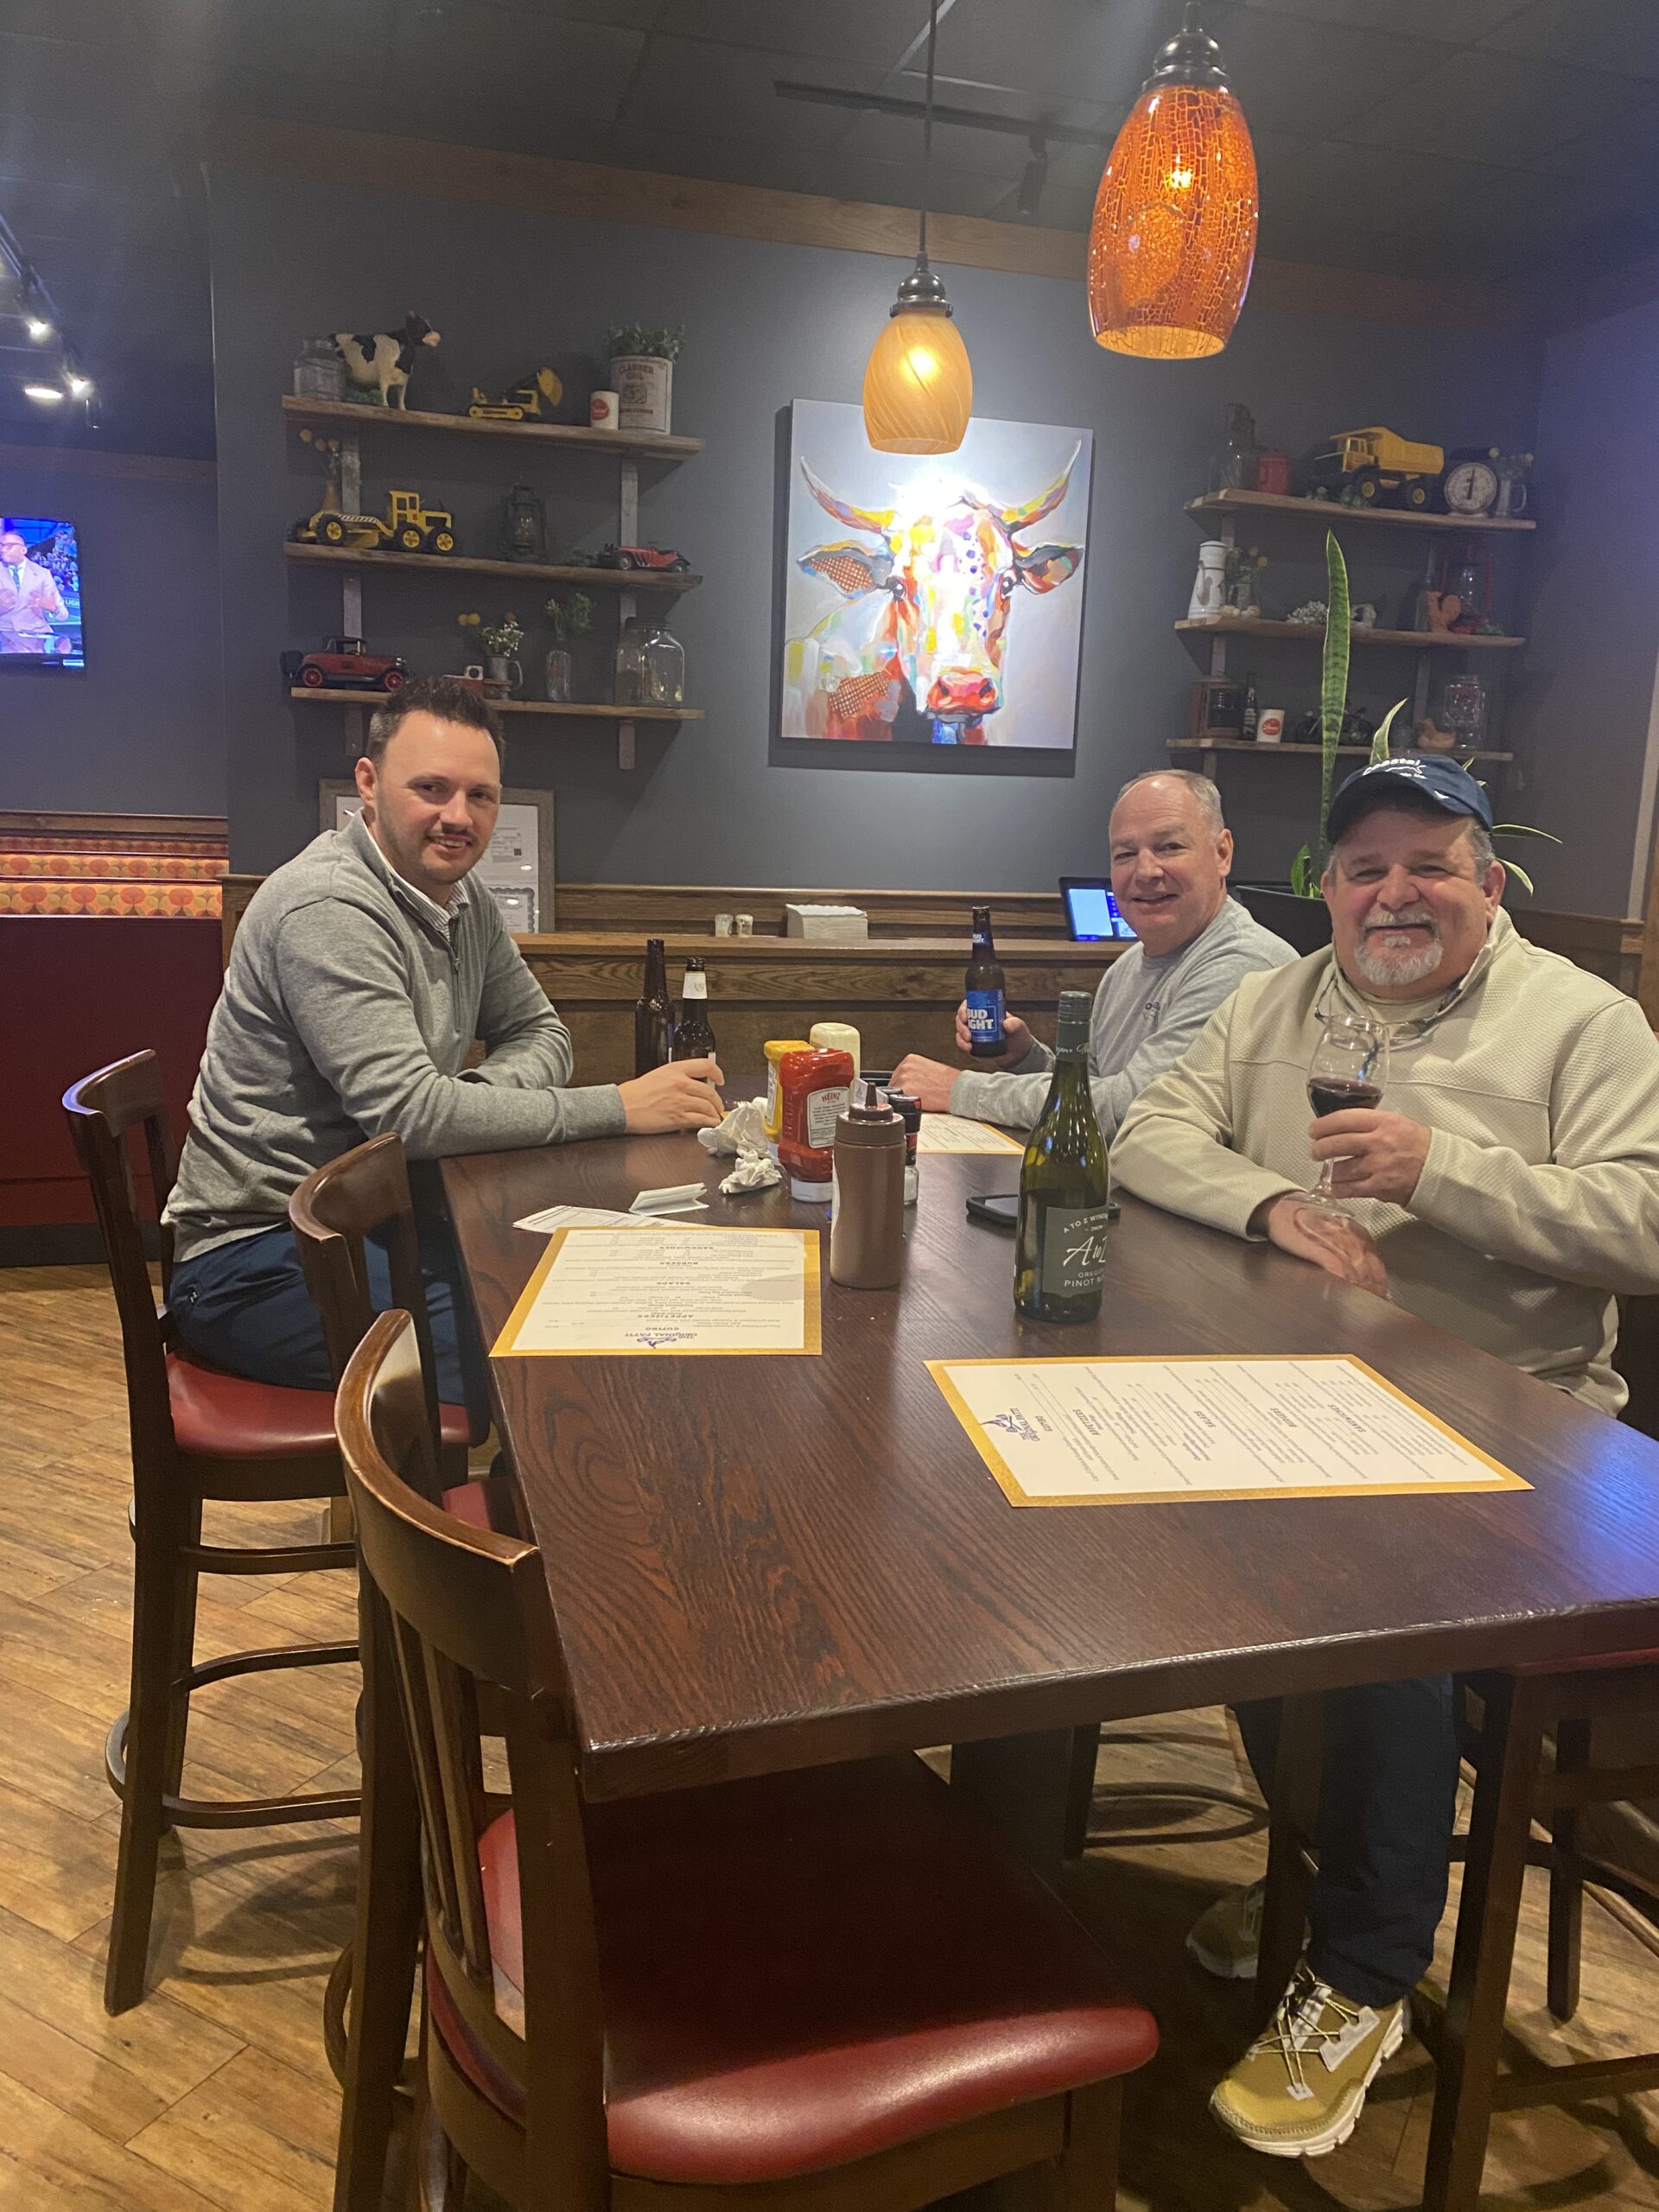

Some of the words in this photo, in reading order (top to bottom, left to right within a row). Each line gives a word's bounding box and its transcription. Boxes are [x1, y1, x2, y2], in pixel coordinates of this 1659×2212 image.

[968, 1019, 994, 1030] IGHT
[821, 1092, 842, 1103] HEINZ
[1070, 1220, 1082, 1229] TO
[1063, 1236, 1094, 1268] A
[1064, 1277, 1095, 1287] PINOT
[1035, 1415, 1052, 1432] GUMBO
[1072, 1408, 1100, 1435] APPETIZERS
[1193, 1410, 1216, 1427] SALADS
[1270, 1407, 1297, 1427] BURGERS
[1327, 1403, 1367, 1432] SANDWICHES
